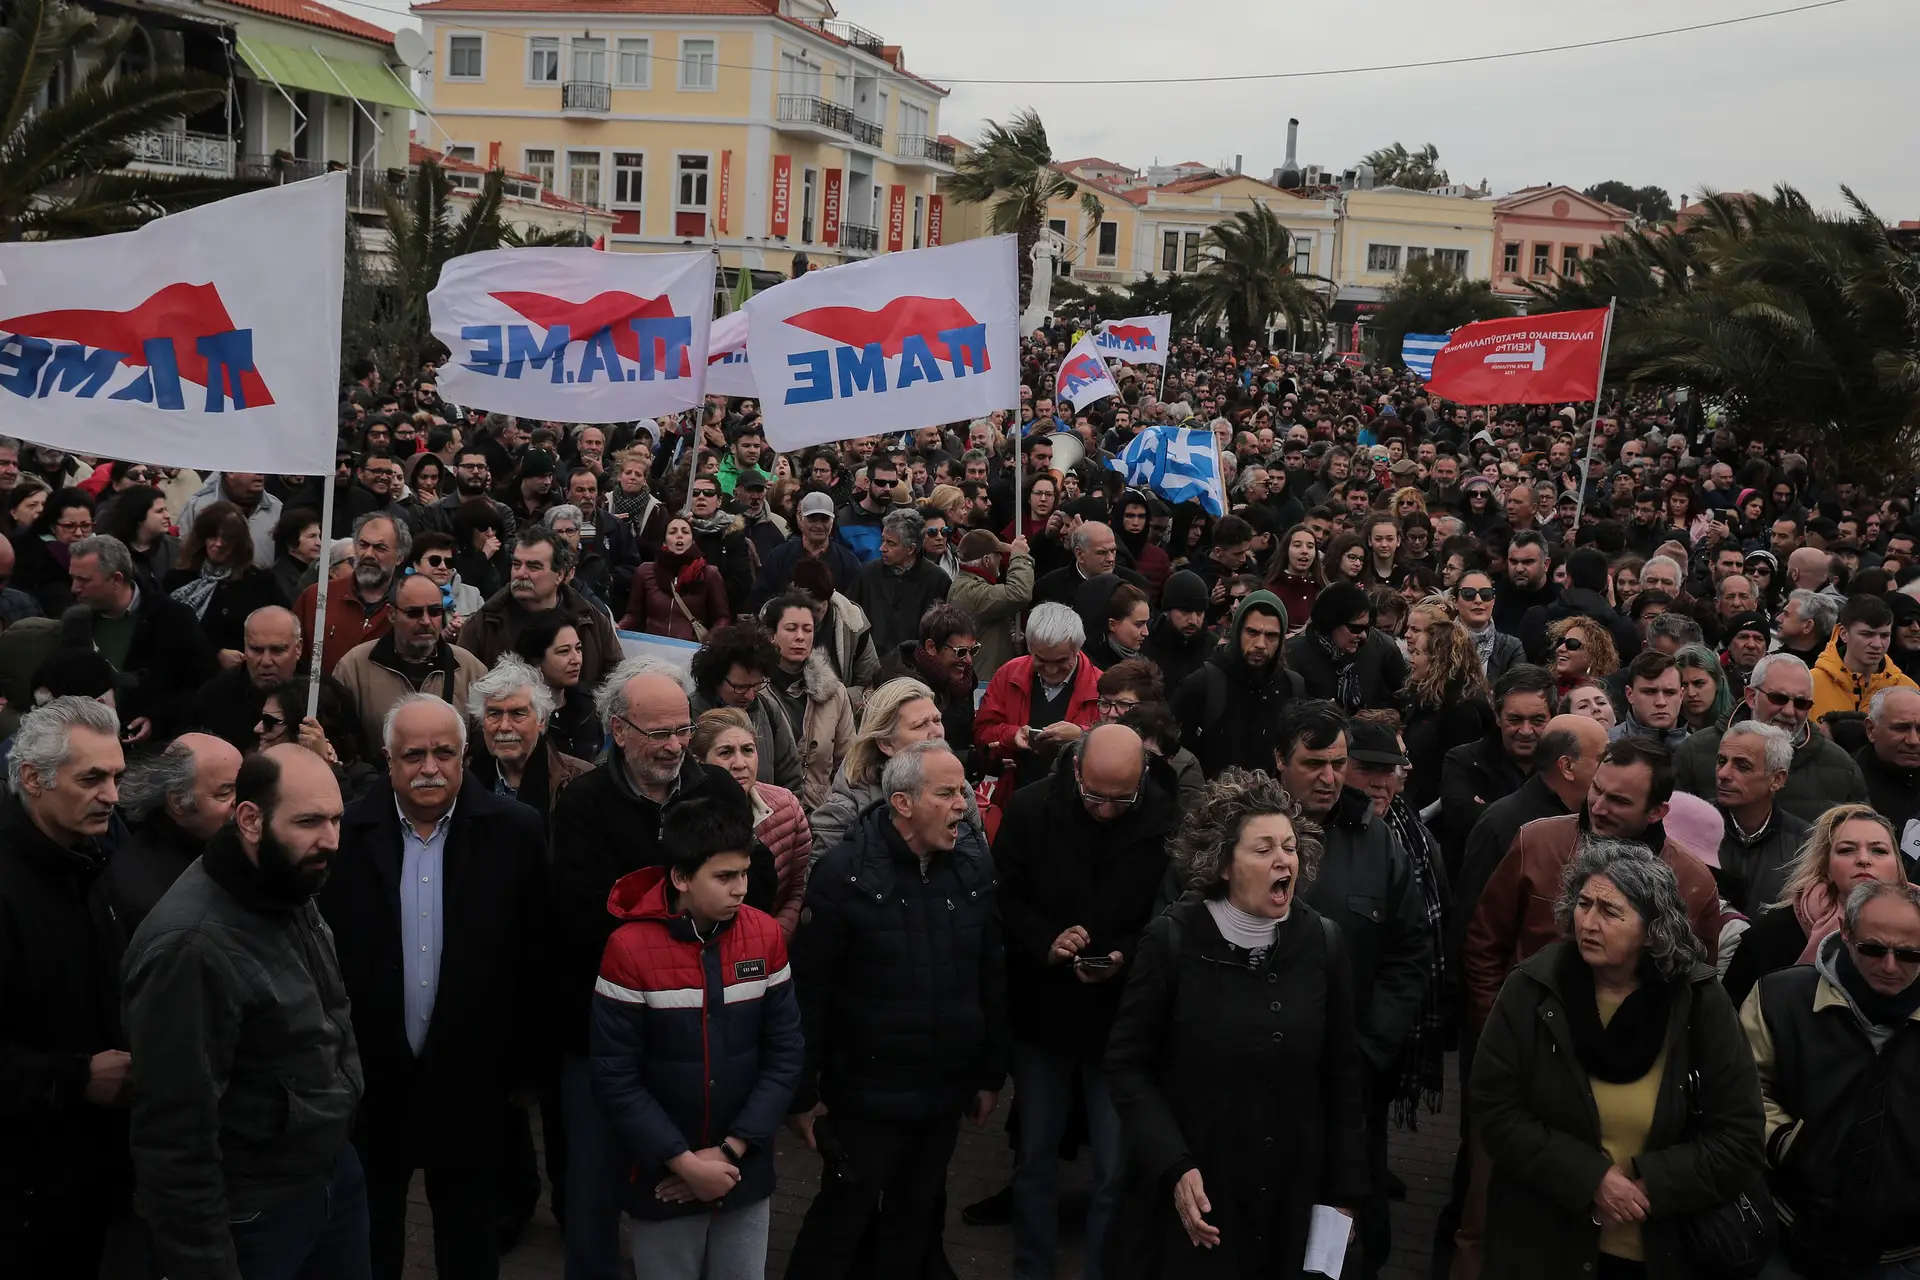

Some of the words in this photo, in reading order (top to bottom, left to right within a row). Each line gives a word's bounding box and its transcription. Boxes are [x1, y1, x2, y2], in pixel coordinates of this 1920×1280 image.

[775, 168, 788, 223] Public
[826, 180, 839, 231] Public
[891, 195, 904, 242] Public
[930, 204, 941, 247] Public
